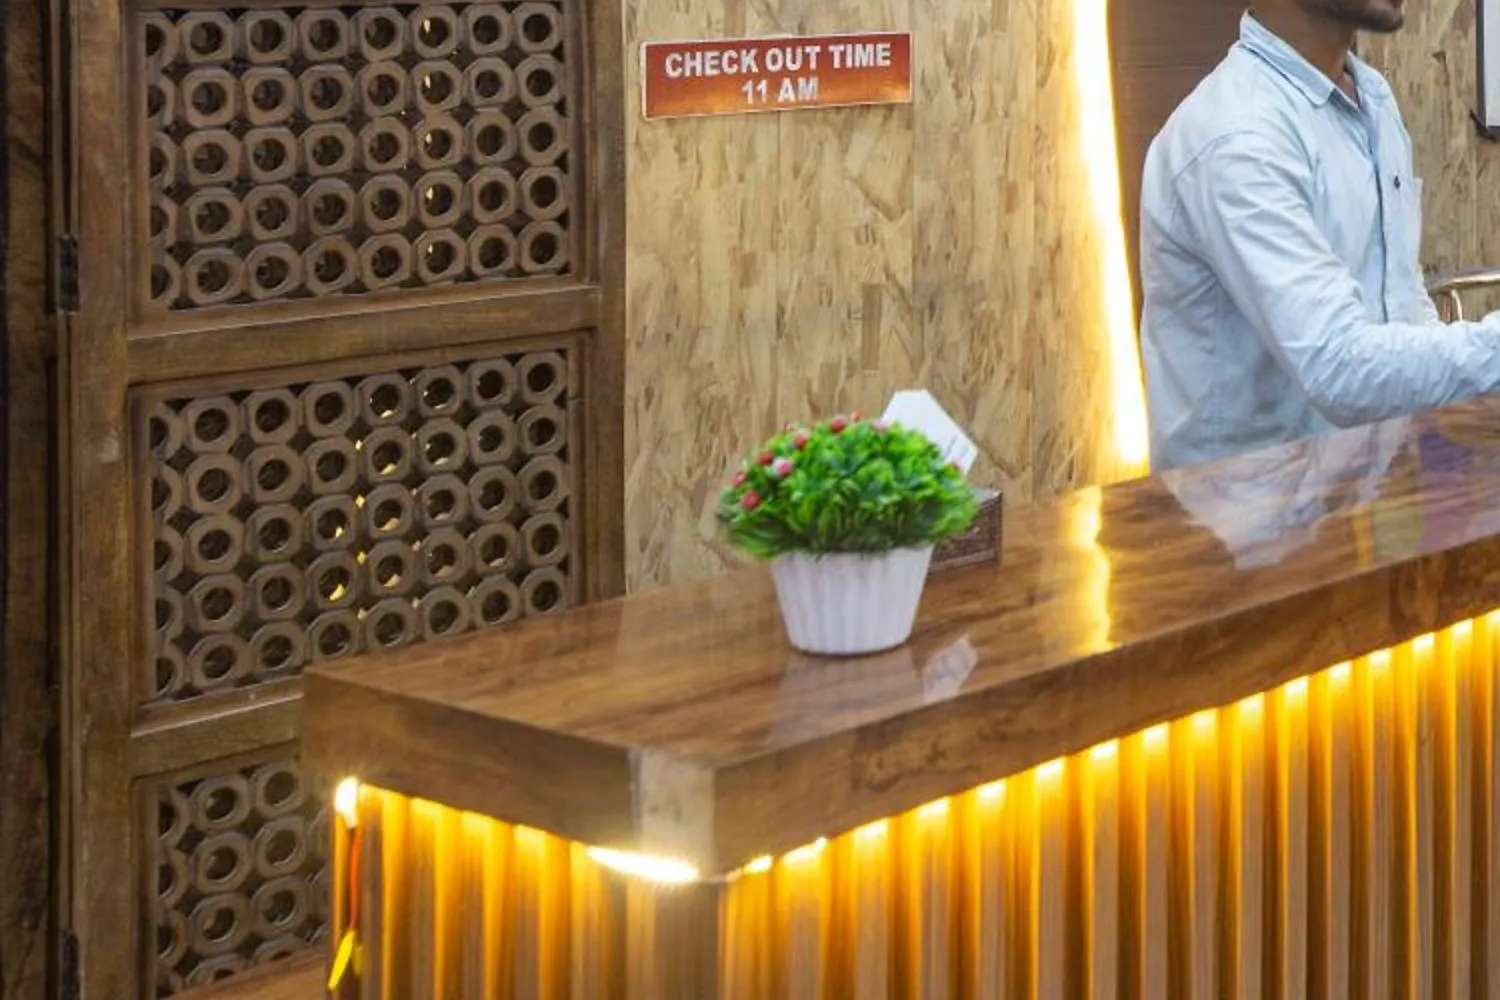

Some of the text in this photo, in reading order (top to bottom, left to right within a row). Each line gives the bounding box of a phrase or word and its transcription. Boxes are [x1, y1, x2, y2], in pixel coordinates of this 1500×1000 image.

[665, 43, 891, 78] CHECK OUT TIME
[742, 77, 818, 104] 11 AM
